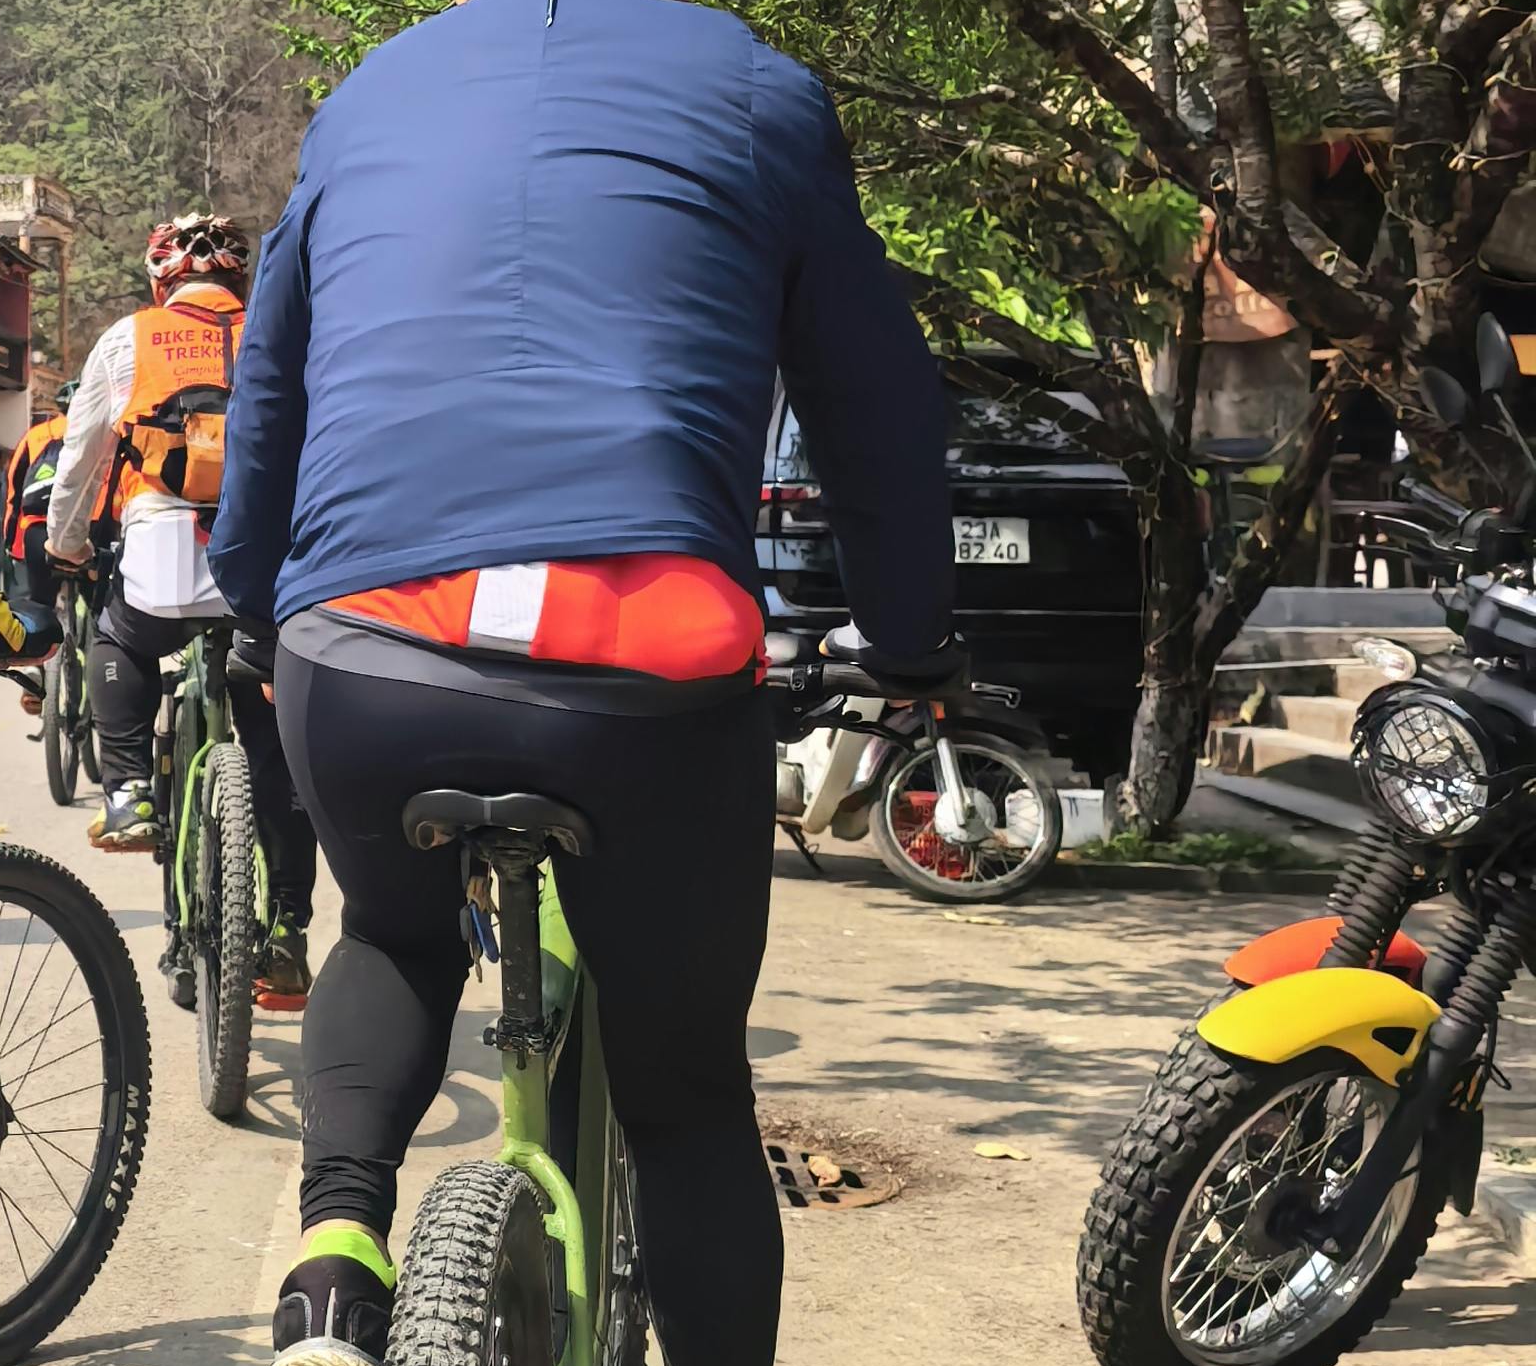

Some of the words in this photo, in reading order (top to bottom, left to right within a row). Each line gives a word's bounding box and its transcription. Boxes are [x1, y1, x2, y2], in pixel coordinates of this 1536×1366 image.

[152, 329, 195, 345] BIKE
[202, 329, 223, 343] RI
[164, 345, 224, 361] TREKK
[961, 521, 1001, 540] 23A
[104, 1083, 140, 1212] MAXXIS
